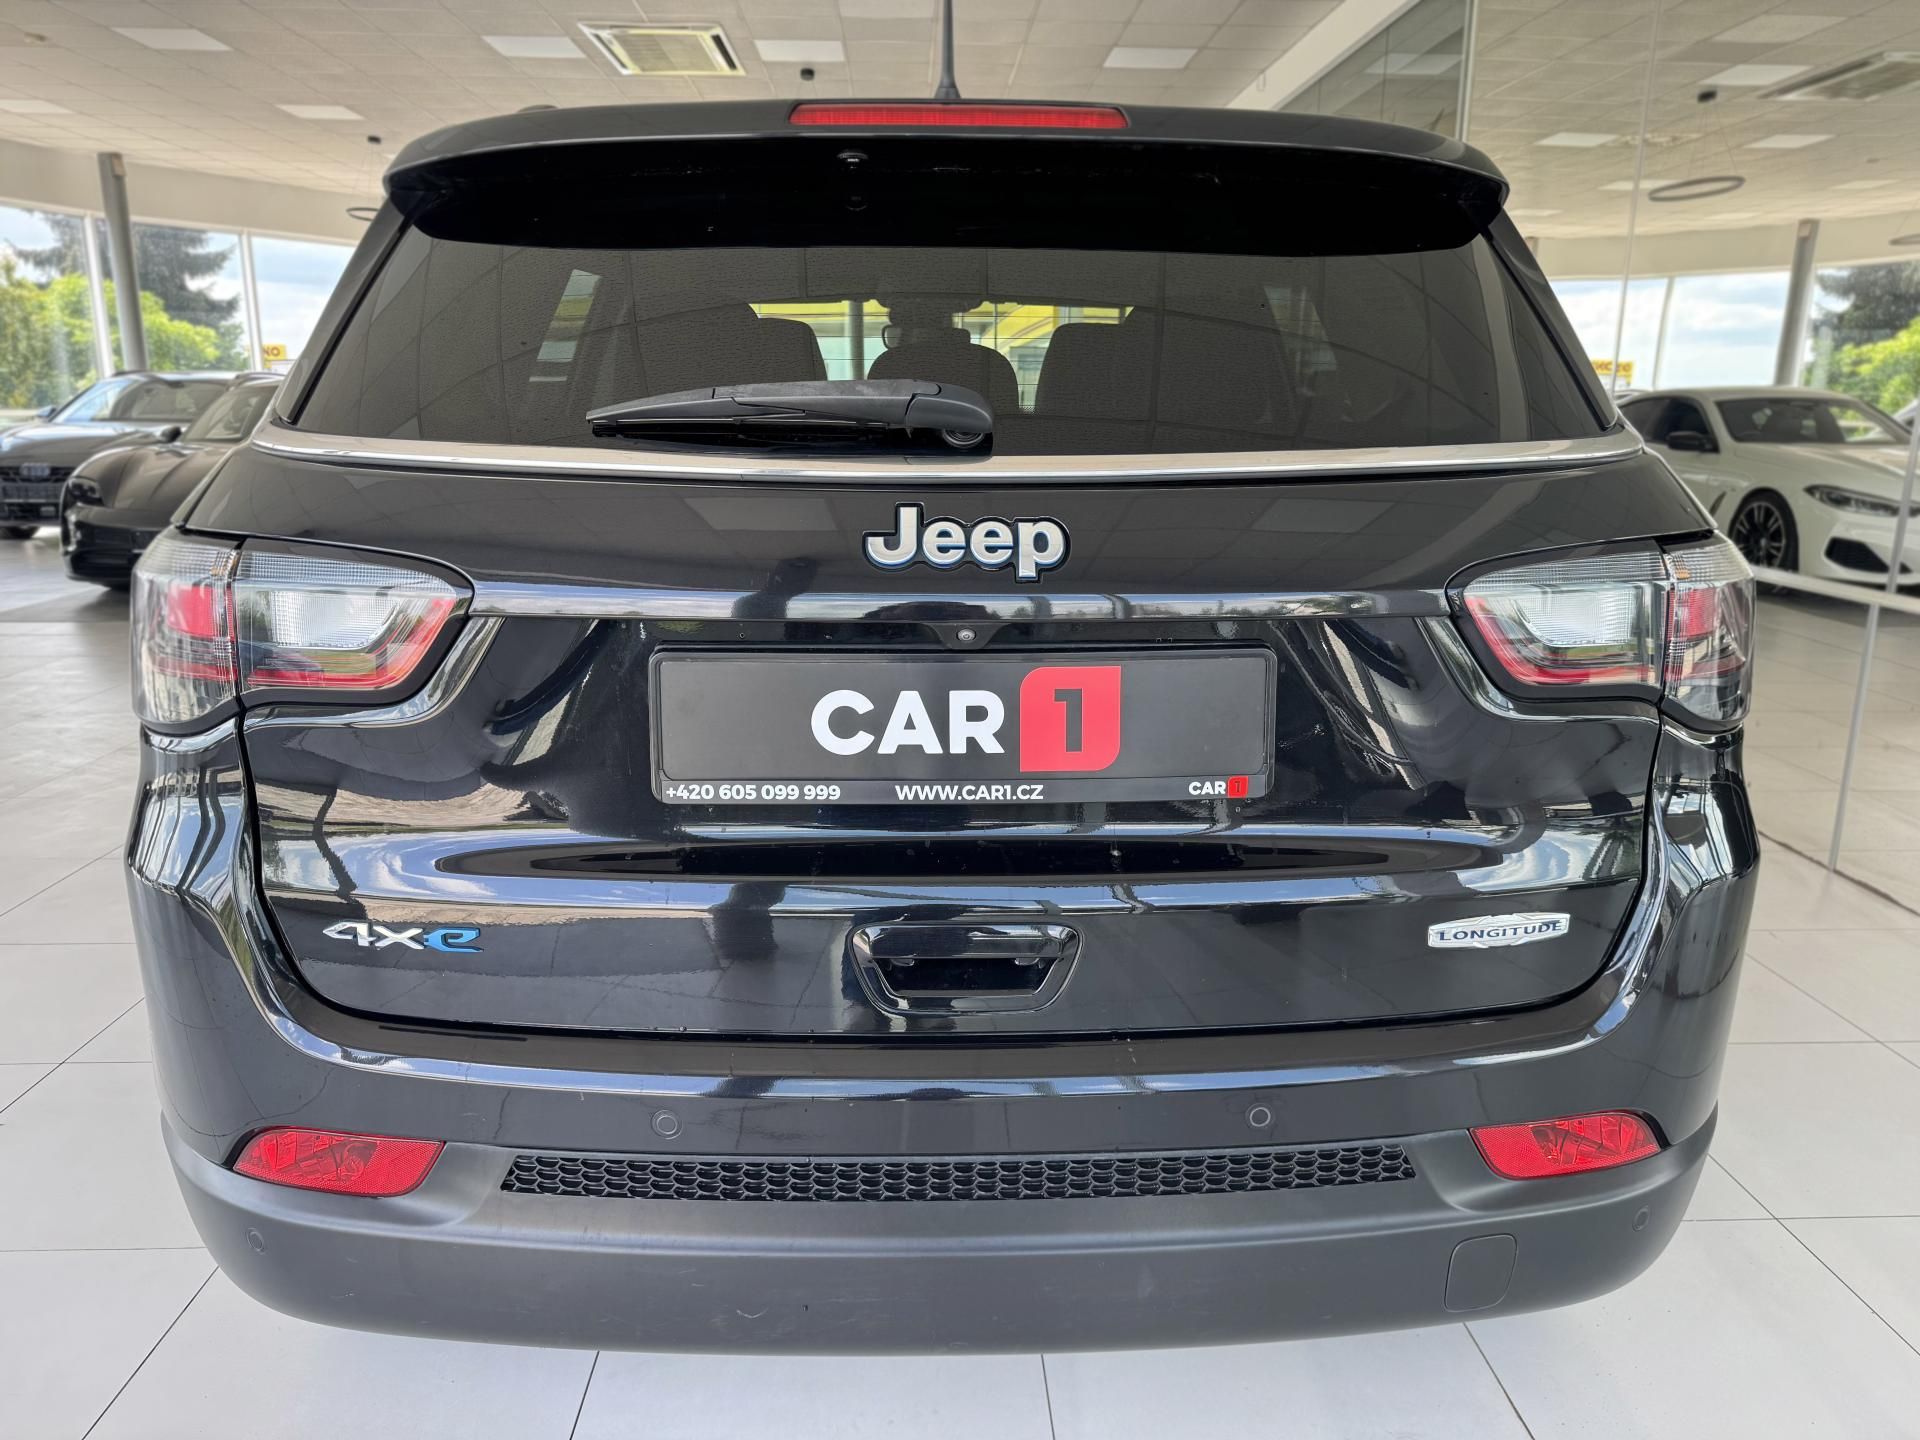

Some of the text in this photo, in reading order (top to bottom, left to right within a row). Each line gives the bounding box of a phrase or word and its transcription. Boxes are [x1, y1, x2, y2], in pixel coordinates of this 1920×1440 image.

[865, 504, 1068, 581] Jeep
[811, 689, 1005, 756] CAR
[666, 784, 841, 800] +420 605 099 999
[895, 784, 1044, 801] WWW.CAR1.CZ
[1188, 781, 1226, 795] CAR
[1438, 919, 1563, 942] LONGITUDE
